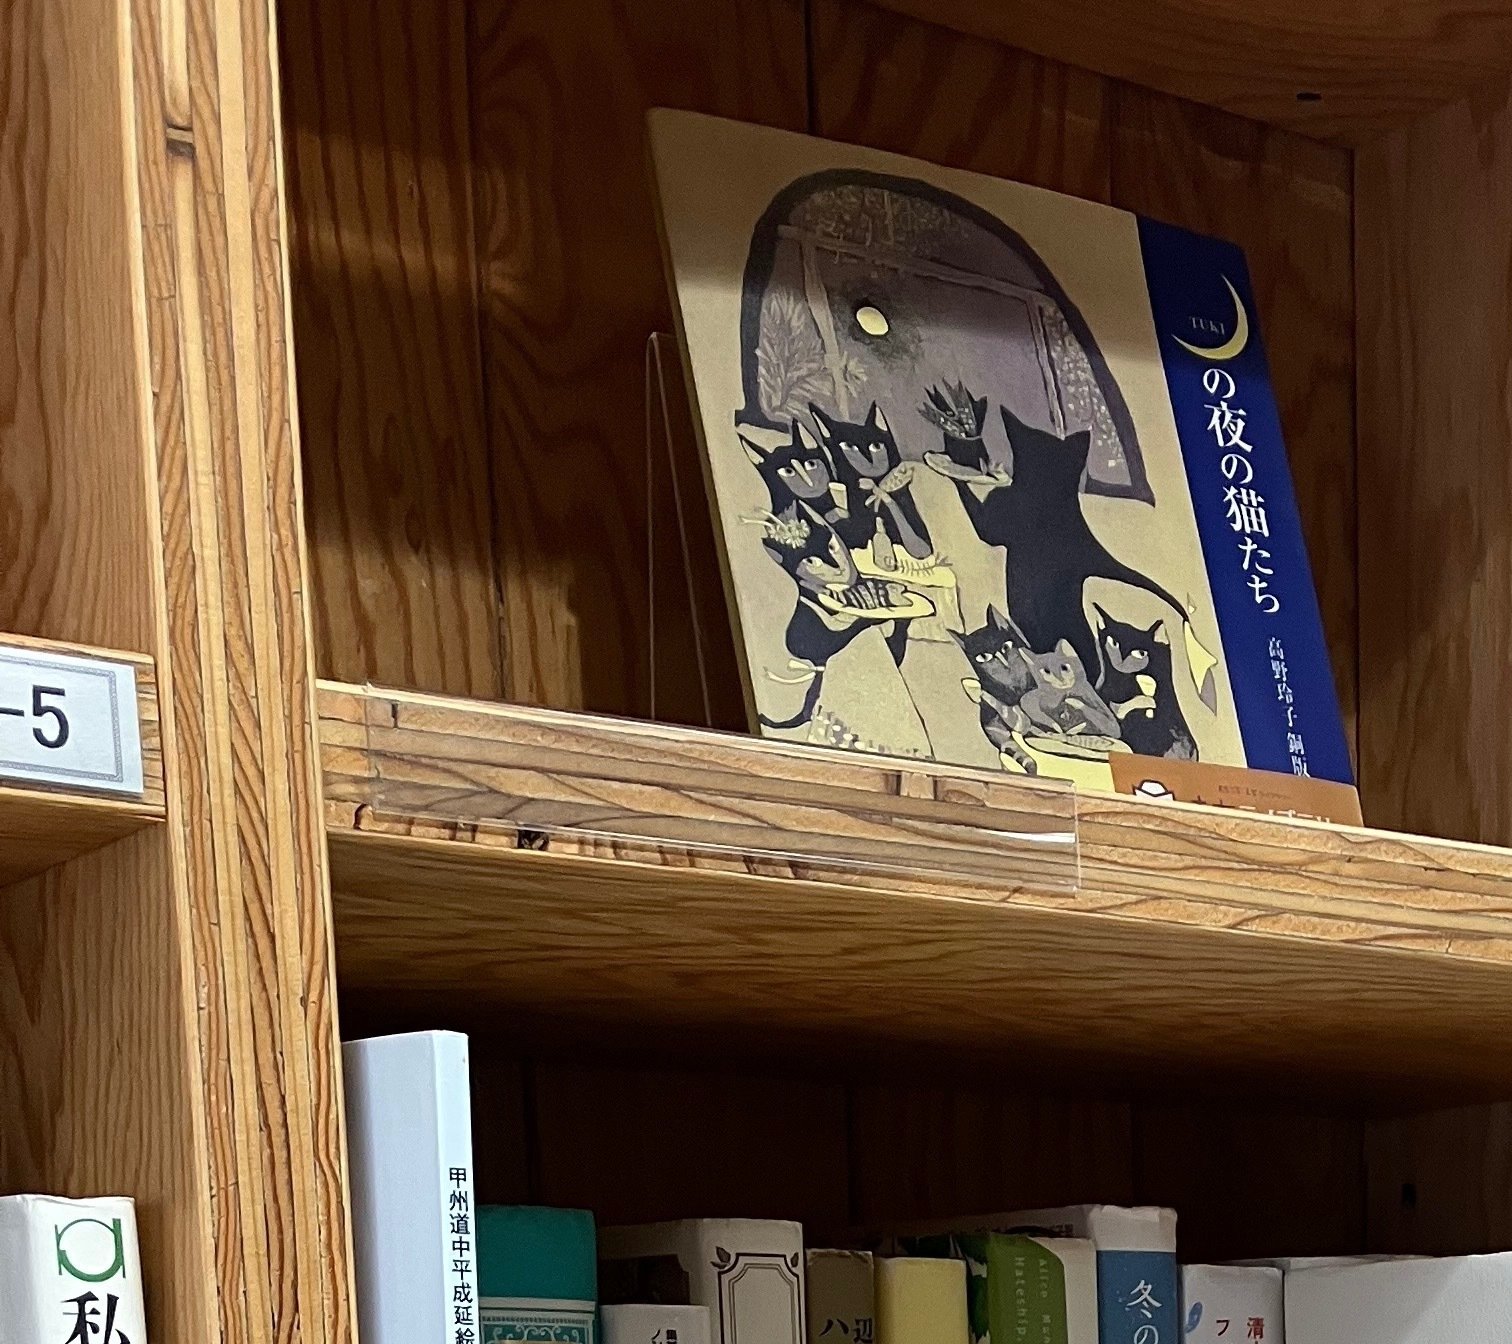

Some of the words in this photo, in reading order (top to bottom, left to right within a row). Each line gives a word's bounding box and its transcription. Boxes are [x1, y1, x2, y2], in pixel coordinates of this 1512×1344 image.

[1189, 315, 1226, 336] TUKI
[1201, 367, 1281, 614] の夜の猫たち
